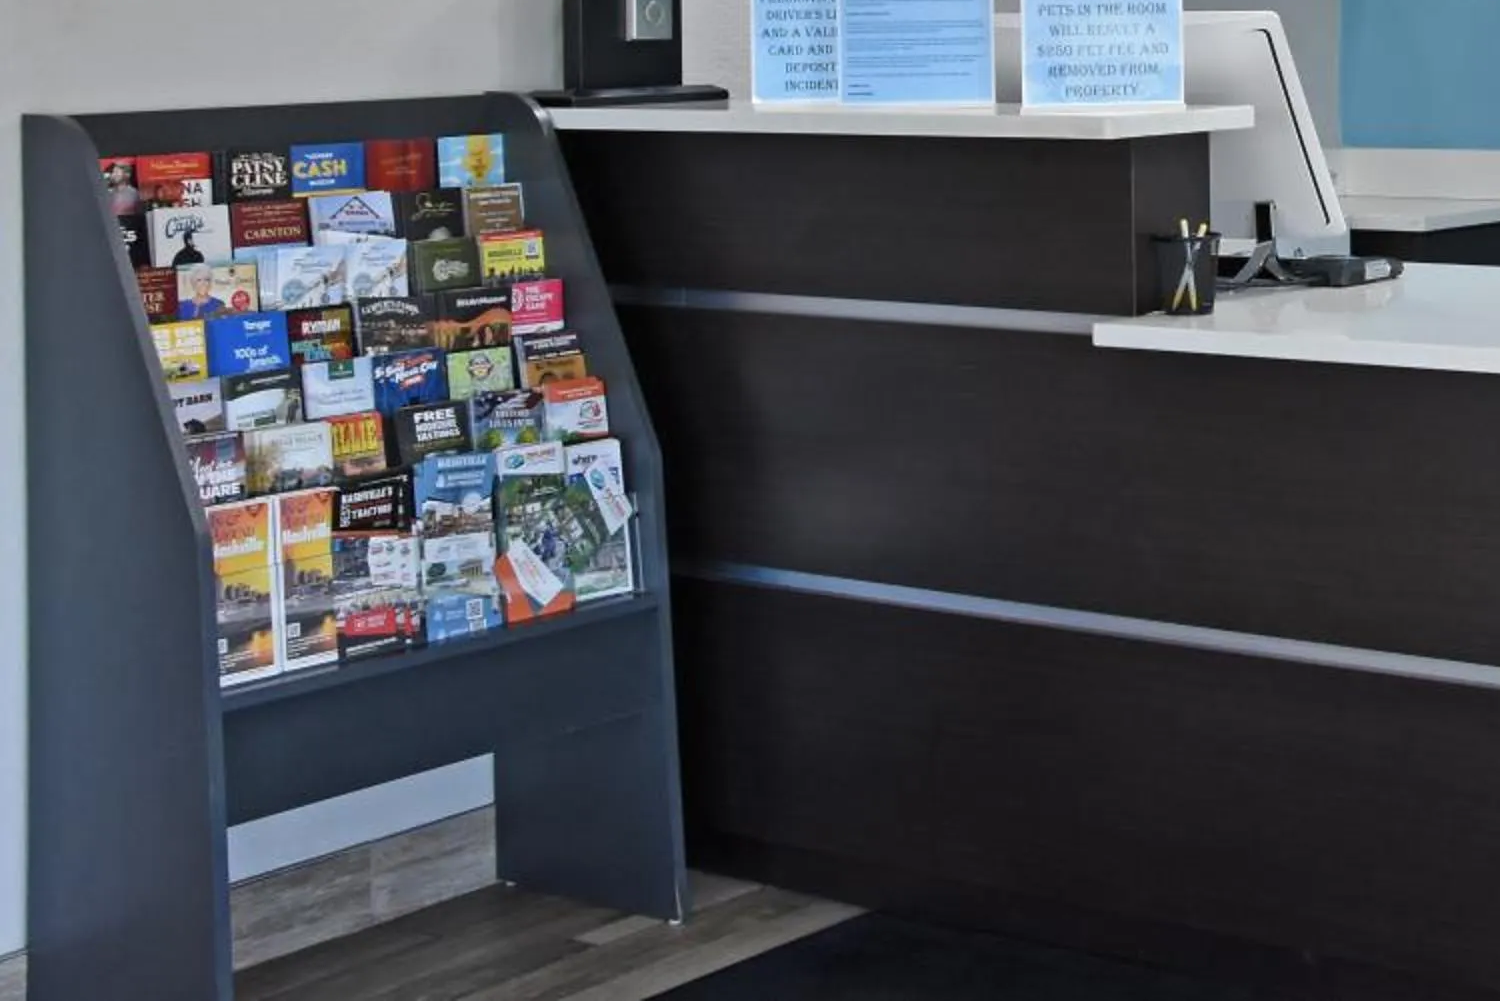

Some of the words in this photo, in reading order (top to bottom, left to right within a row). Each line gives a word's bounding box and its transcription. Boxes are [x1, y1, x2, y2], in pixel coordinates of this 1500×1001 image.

[1038, 3, 1075, 17] PETS
[1077, 4, 1092, 16] IN
[1127, 2, 1167, 16] ROOM
[1048, 25, 1085, 38] WILL
[1145, 23, 1156, 35] A
[807, 44, 833, 56] AND
[1140, 43, 1169, 55] AND
[1047, 64, 1117, 78] REMOVED
[231, 159, 285, 175] PATSY
[293, 159, 348, 178] CASH
[231, 172, 288, 187] CLINE
[244, 227, 302, 240] CARNTON
[301, 318, 341, 335] RYMAN
[413, 408, 457, 425] FREE
[200, 482, 242, 500] UARE
